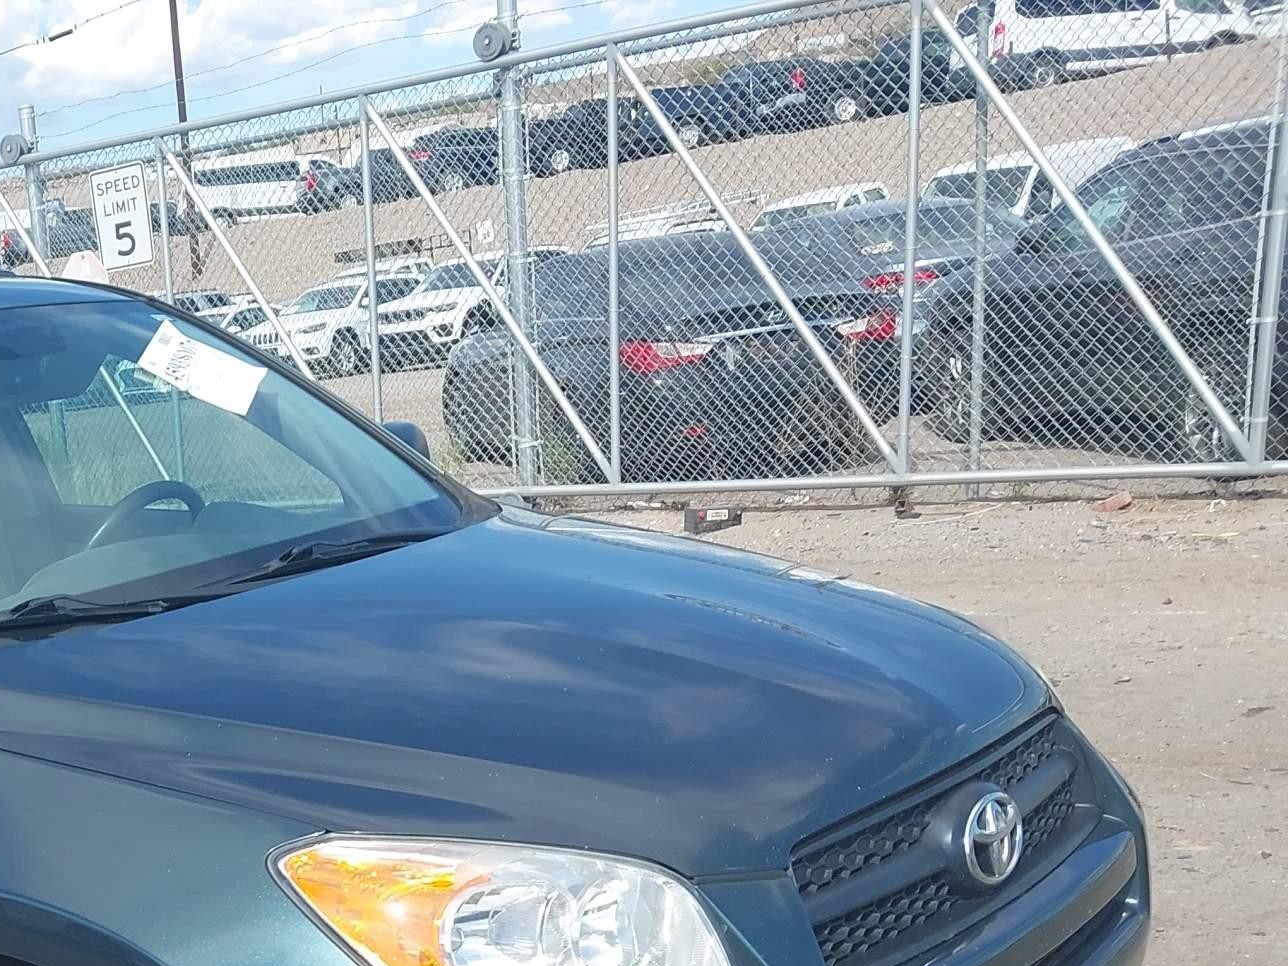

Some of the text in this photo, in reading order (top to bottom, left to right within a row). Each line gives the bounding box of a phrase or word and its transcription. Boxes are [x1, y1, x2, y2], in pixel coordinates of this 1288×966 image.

[96, 175, 140, 197] SPEED
[103, 197, 137, 217] LIMIT
[114, 220, 136, 256] 5
